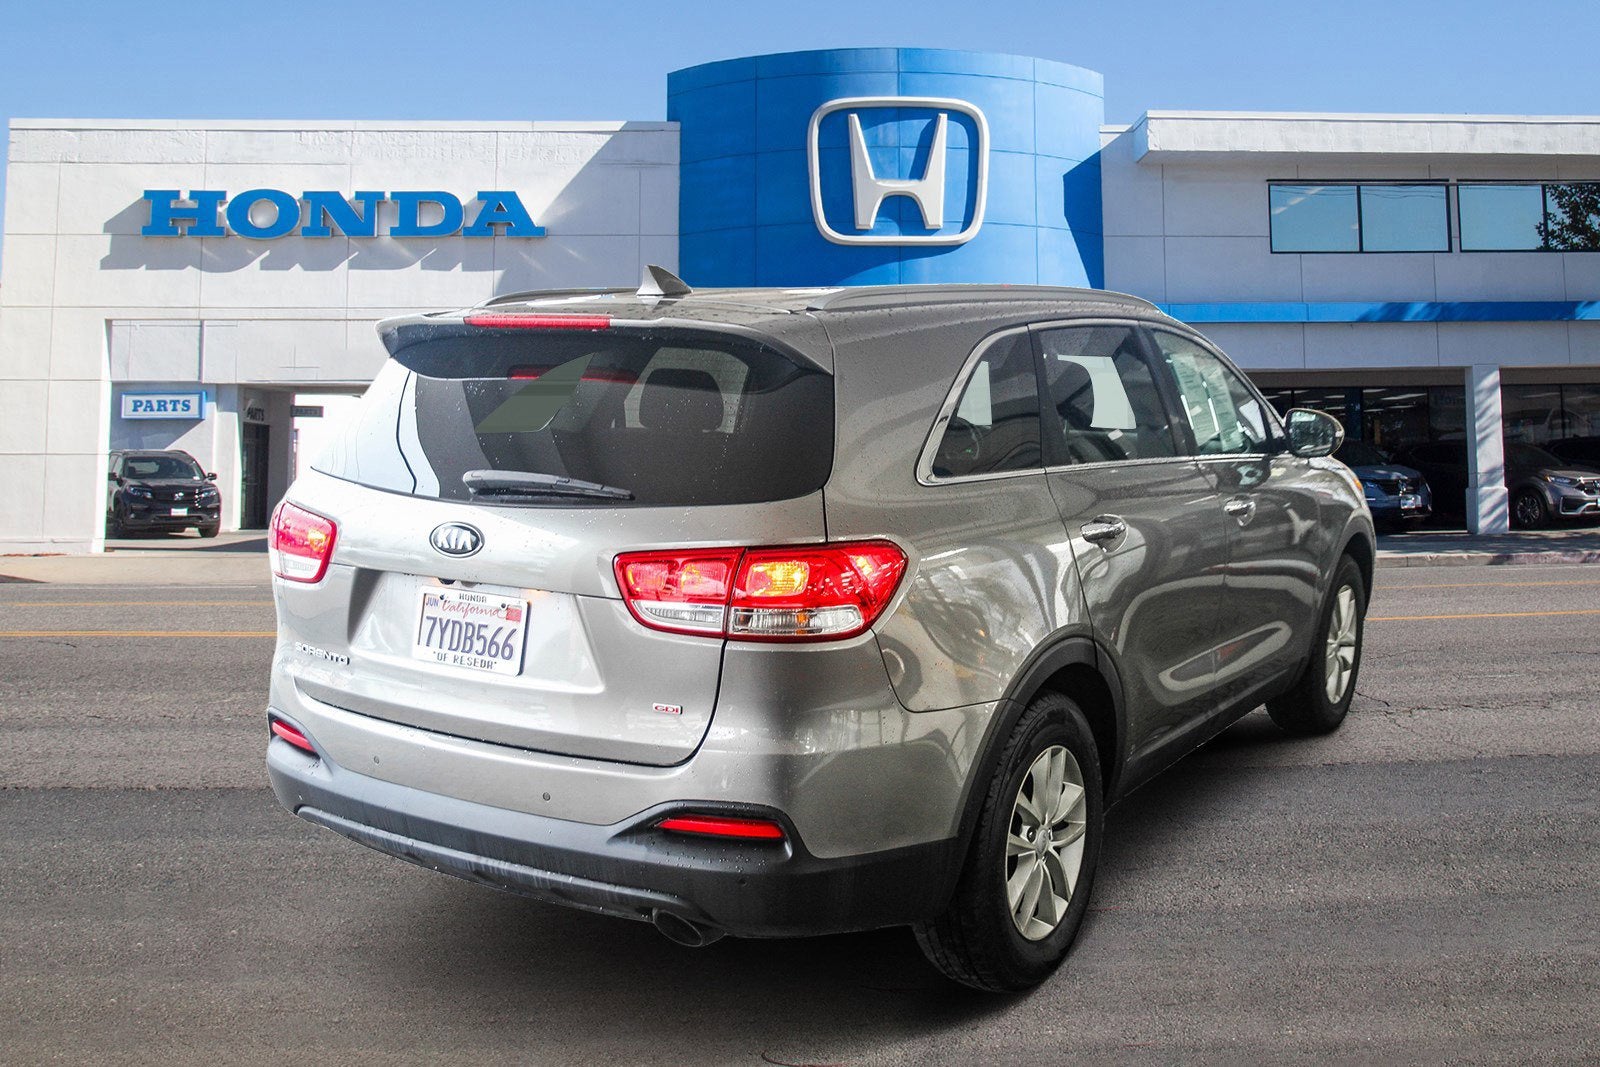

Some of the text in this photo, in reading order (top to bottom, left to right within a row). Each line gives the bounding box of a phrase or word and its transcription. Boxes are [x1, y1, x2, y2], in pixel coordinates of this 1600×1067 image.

[142, 188, 547, 240] HONDA
[132, 400, 191, 412] PARTS
[437, 528, 473, 551] KIA
[425, 597, 439, 607] JUN
[459, 593, 487, 603] HONDA
[441, 599, 507, 619] California
[425, 615, 517, 661] 7YDB566
[436, 652, 493, 669] OF RESEDA
[654, 705, 679, 713] GDI
